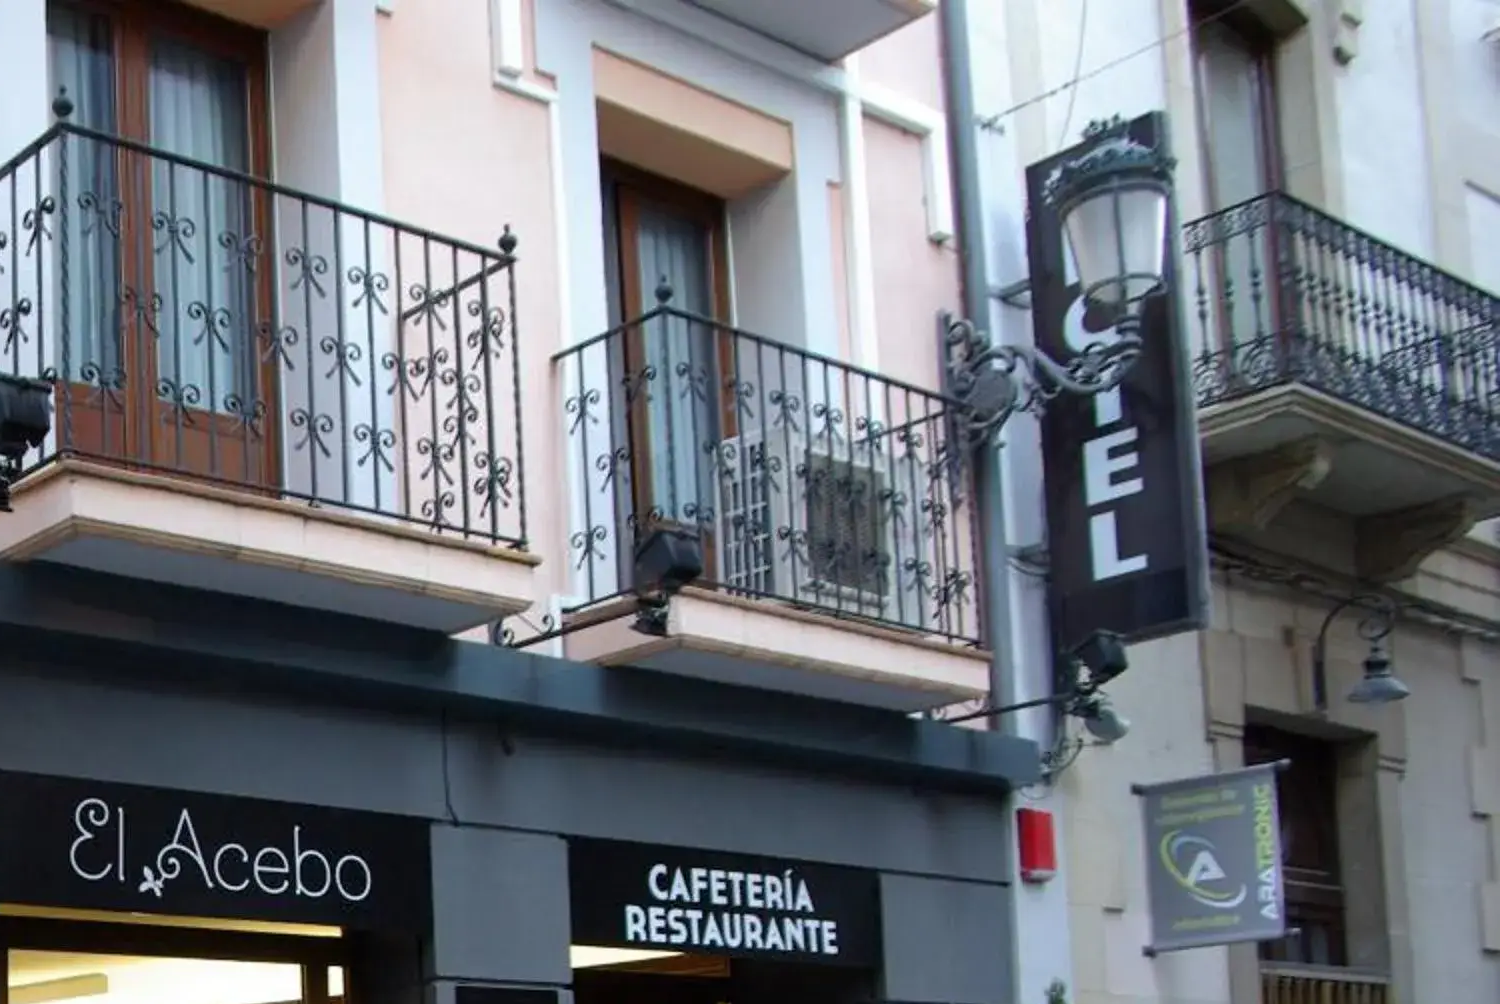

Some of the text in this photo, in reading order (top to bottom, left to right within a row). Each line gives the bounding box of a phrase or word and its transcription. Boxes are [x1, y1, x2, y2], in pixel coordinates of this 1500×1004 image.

[69, 798, 372, 901] El Acebo
[648, 863, 814, 913] CAFETERÍA
[624, 904, 839, 955] RESTAURANTE
